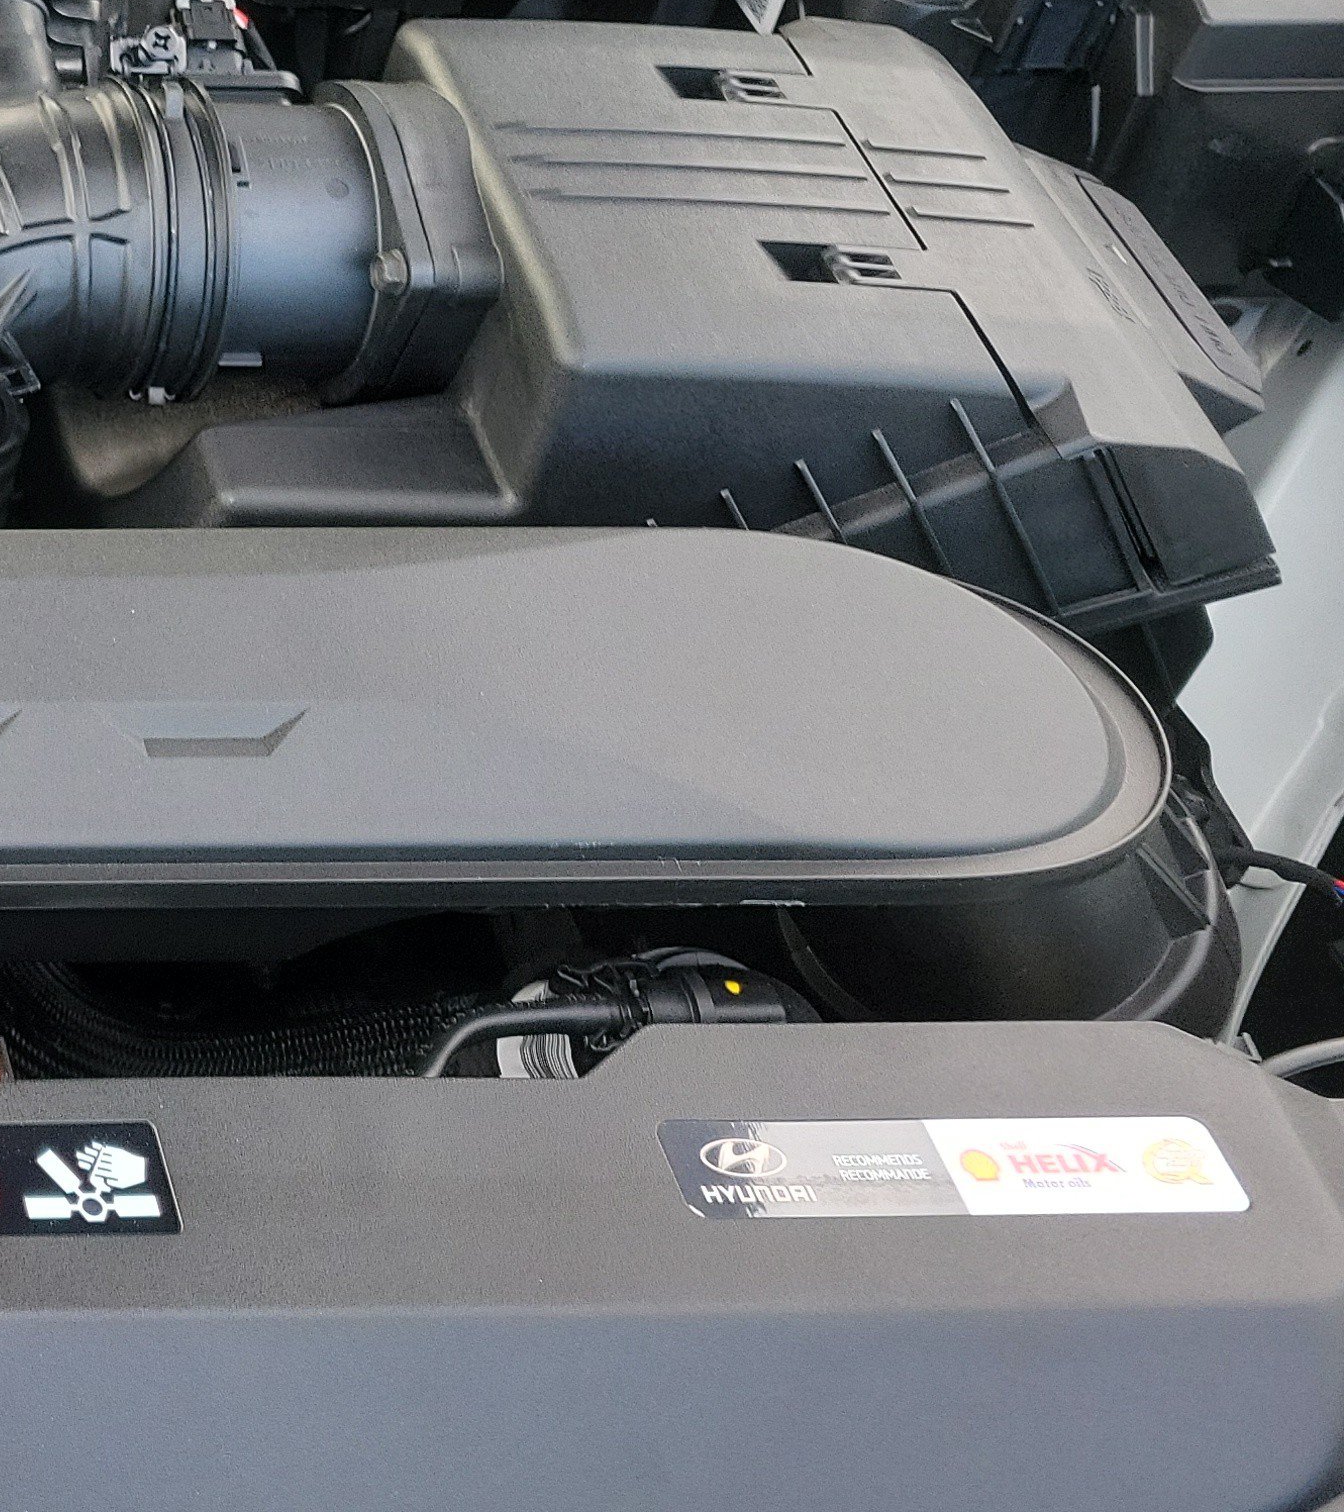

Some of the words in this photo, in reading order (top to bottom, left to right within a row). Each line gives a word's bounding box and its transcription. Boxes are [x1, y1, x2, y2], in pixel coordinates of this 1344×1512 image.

[831, 1154, 924, 1166] RECOMMENDS
[1008, 1153, 1120, 1174] HELIX
[838, 1168, 932, 1181] RECOMMANDE
[1023, 1178, 1065, 1189] Motor
[1068, 1177, 1093, 1188] oils
[699, 1185, 819, 1204] HYUNDAI
